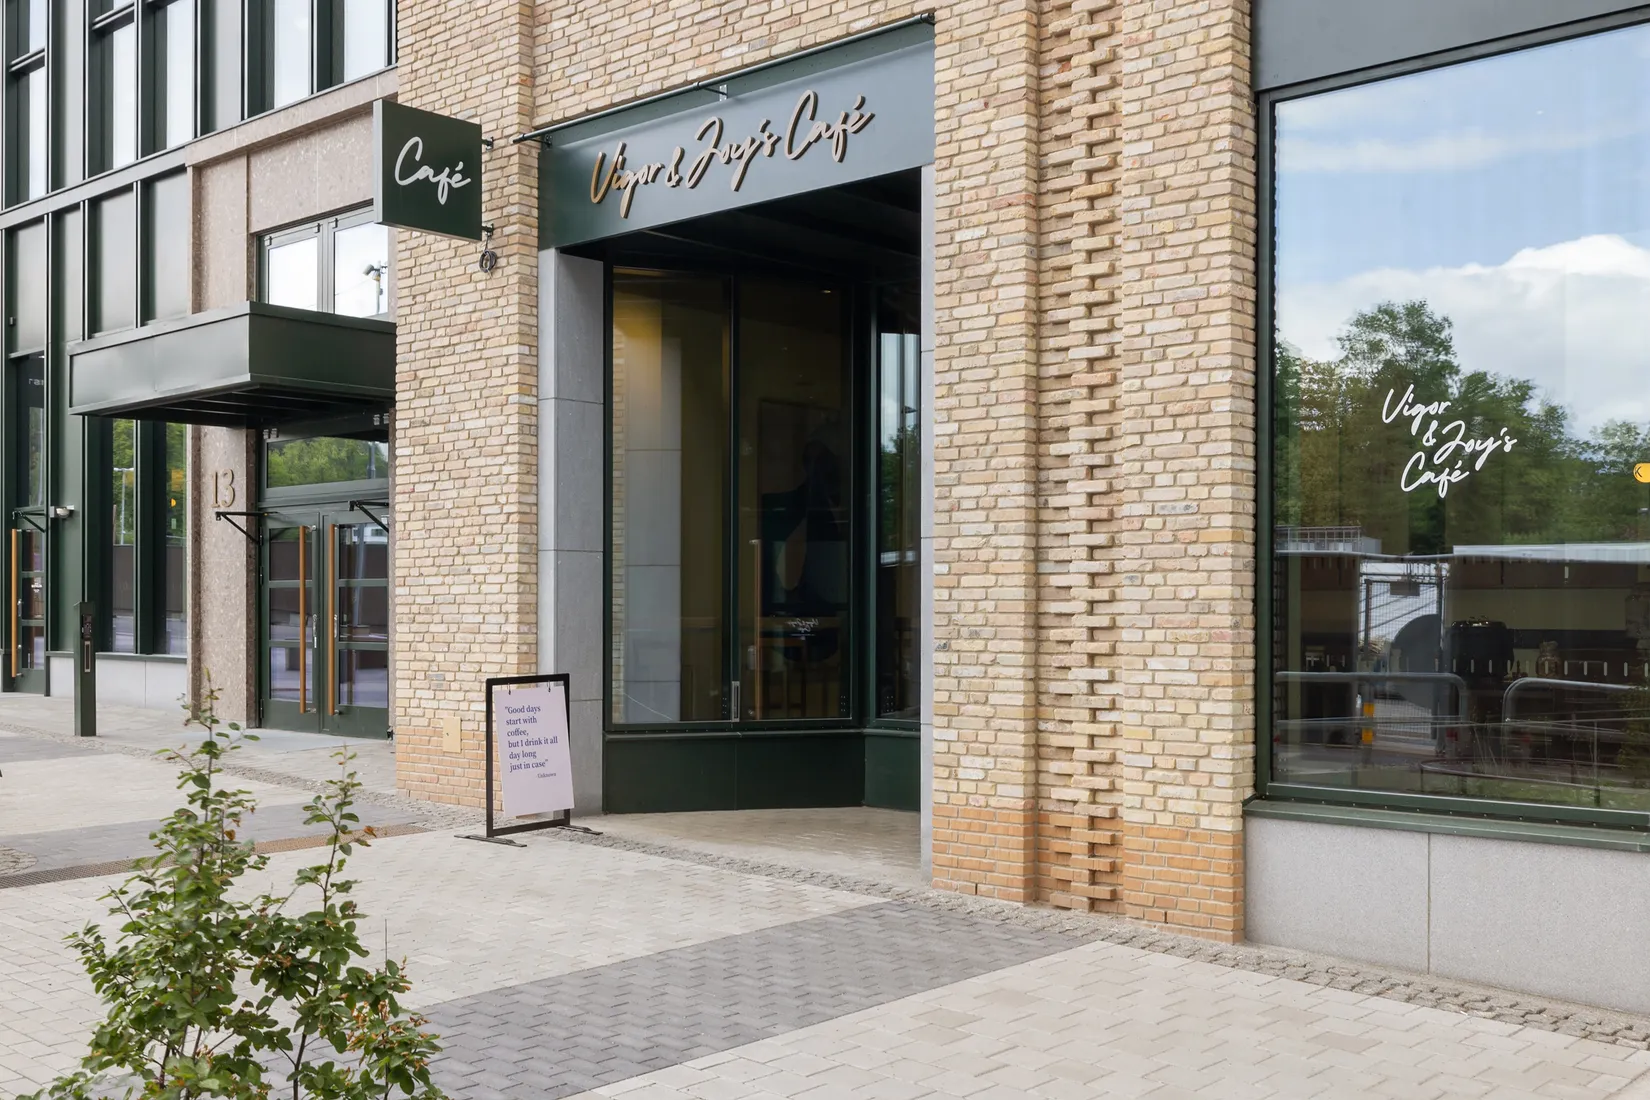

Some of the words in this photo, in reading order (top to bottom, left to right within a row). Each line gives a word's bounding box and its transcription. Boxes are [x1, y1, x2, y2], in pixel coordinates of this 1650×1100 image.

[590, 141, 666, 219] Vigor
[665, 145, 685, 188] &
[686, 116, 782, 192] Joy's
[784, 89, 875, 163] Café
[394, 136, 472, 206] Café
[1381, 383, 1452, 436] Vigor
[1422, 419, 1438, 447] &
[1433, 419, 1518, 471] Joy's
[211, 468, 236, 508] 13
[1400, 451, 1470, 499] Café
[522, 716, 538, 724] with
[526, 705, 541, 715] days
[507, 728, 529, 737] coffee,
[508, 740, 520, 748] but
[520, 739, 524, 747] I
[524, 738, 543, 747] drink
[543, 736, 549, 745] it
[550, 736, 558, 744] all
[509, 751, 521, 761] day
[521, 750, 537, 759] long
[510, 762, 523, 773] just
[523, 761, 531, 769] in
